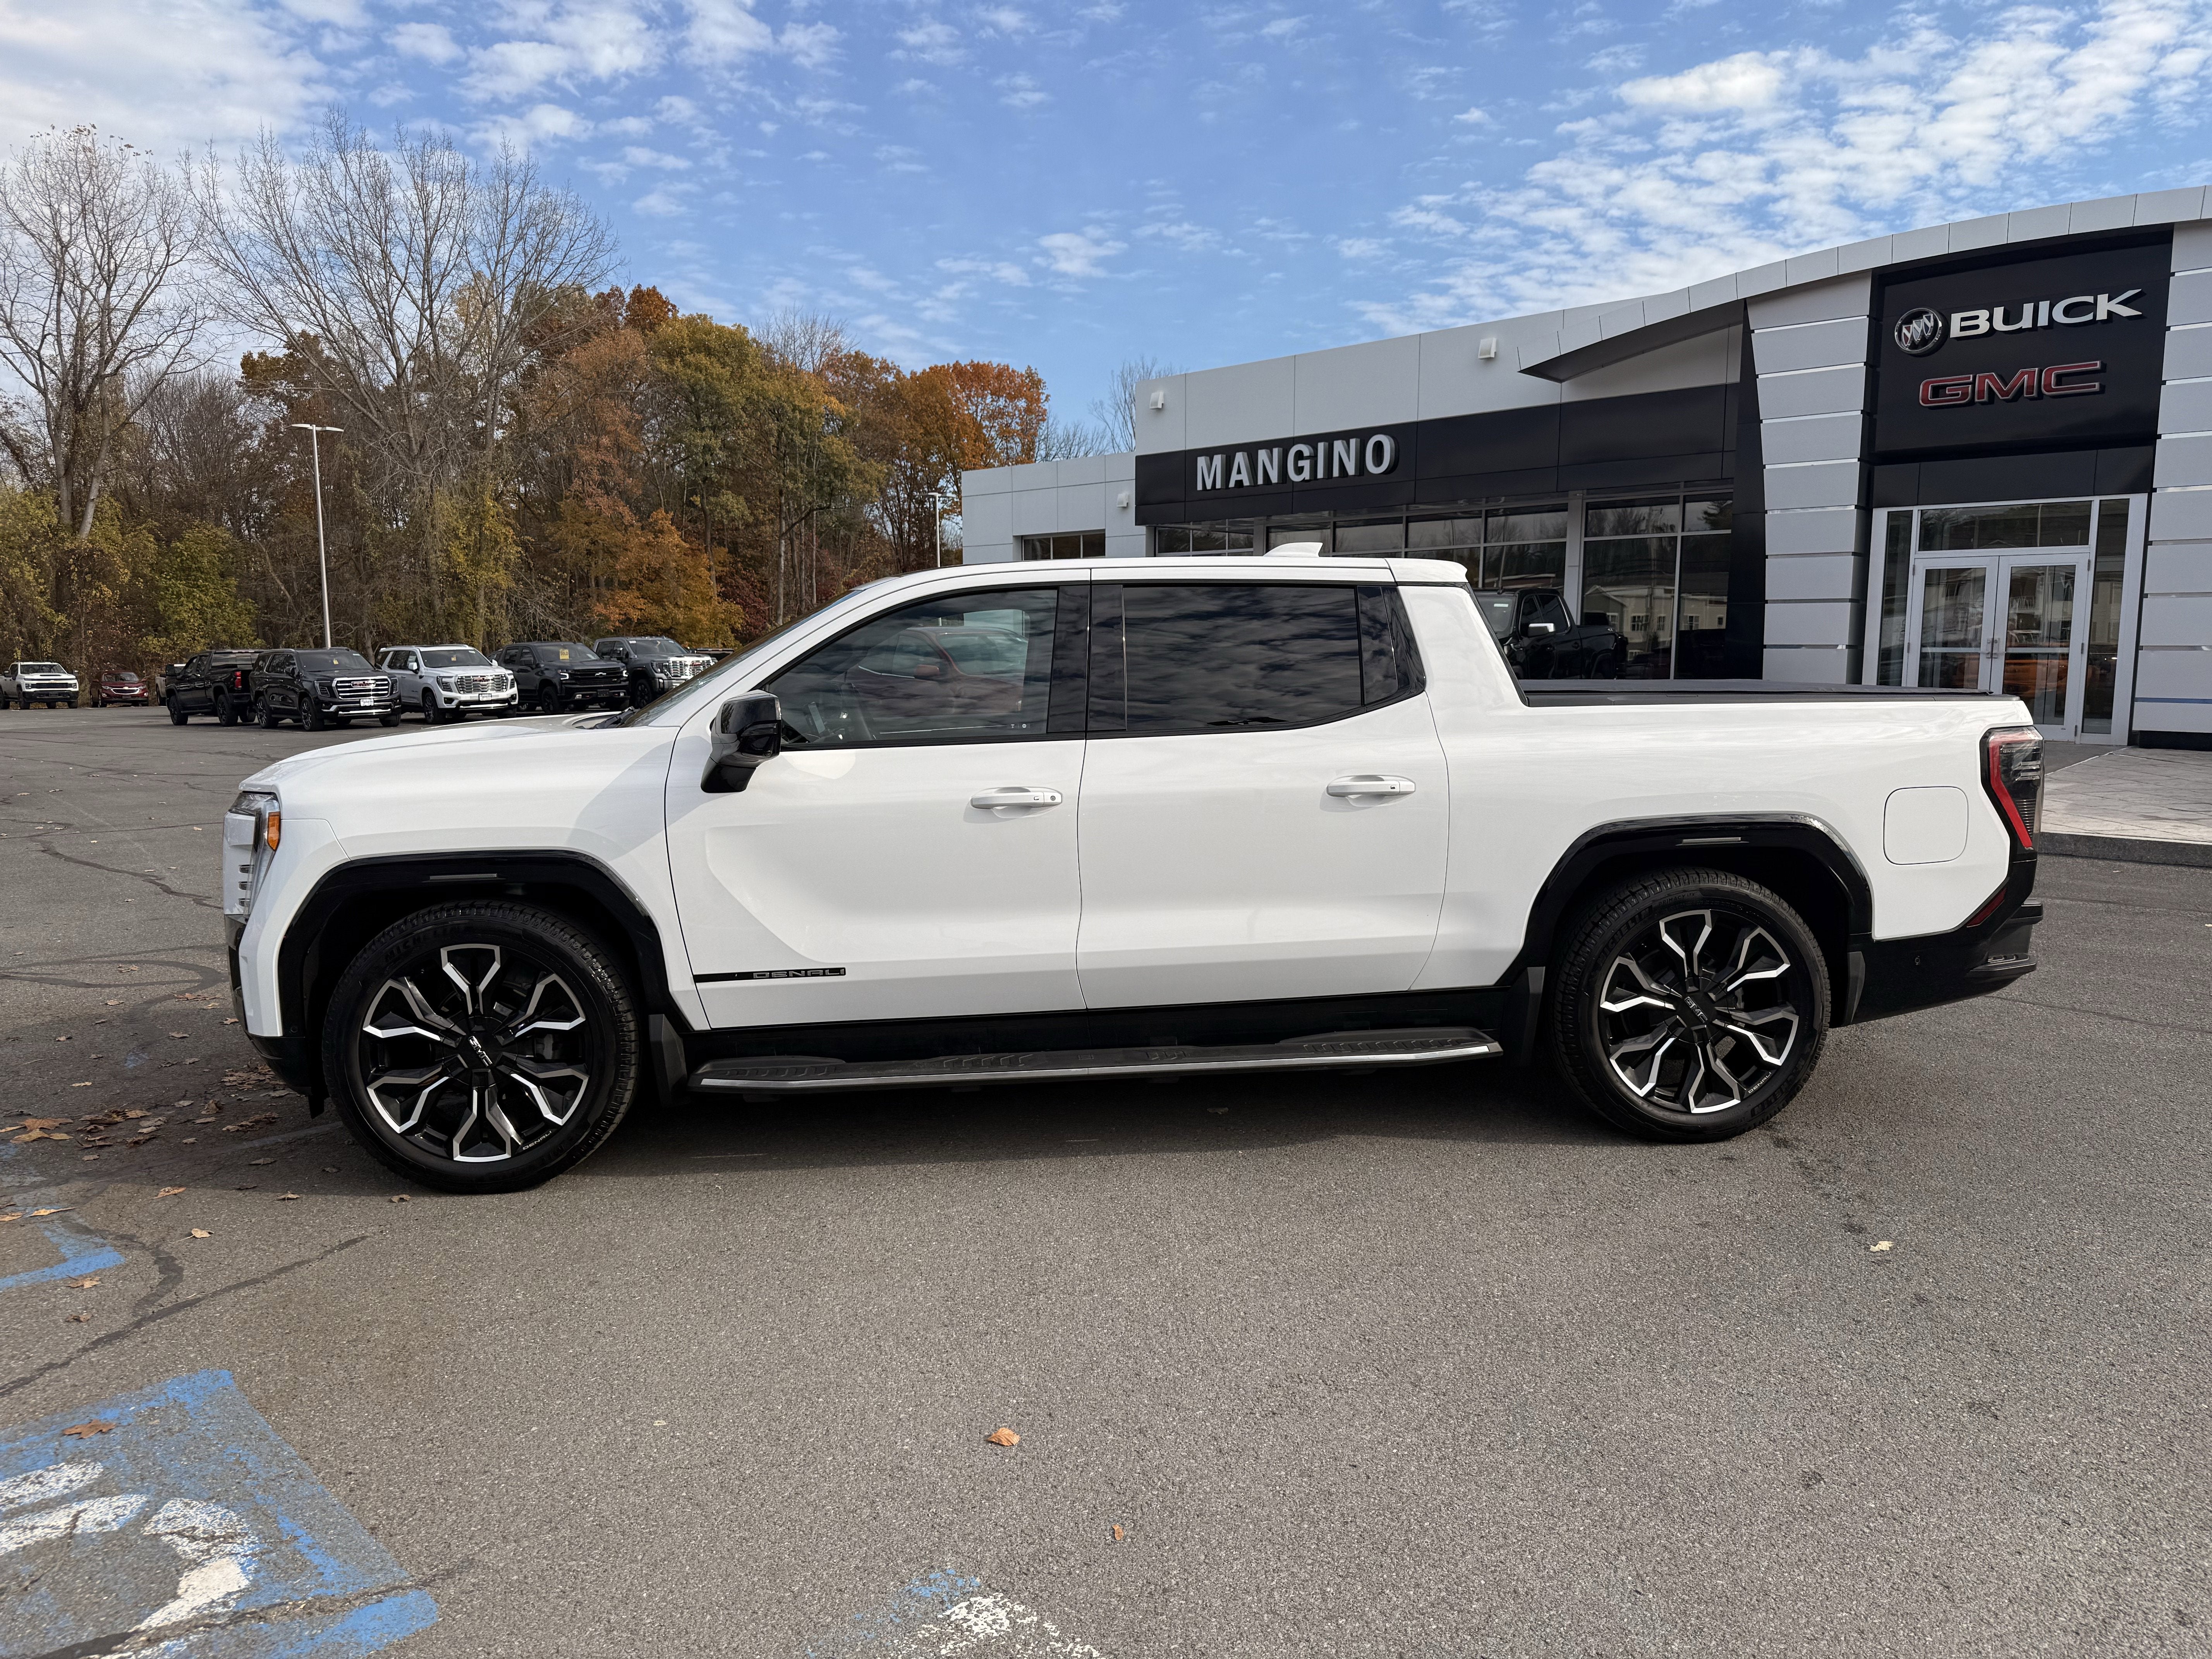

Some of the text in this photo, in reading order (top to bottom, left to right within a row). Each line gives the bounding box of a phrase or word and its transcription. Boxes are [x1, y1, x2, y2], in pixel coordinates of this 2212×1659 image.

[1950, 288, 2143, 338] BUICK
[1919, 360, 2102, 407] GMC
[1197, 433, 1396, 491] MANGINO
[753, 969, 844, 979] DENALI
[1685, 996, 1707, 1023] GMC
[468, 1036, 493, 1066] GMC
[1748, 1072, 1772, 1093] DENALI
[523, 1130, 551, 1150] DENALI
